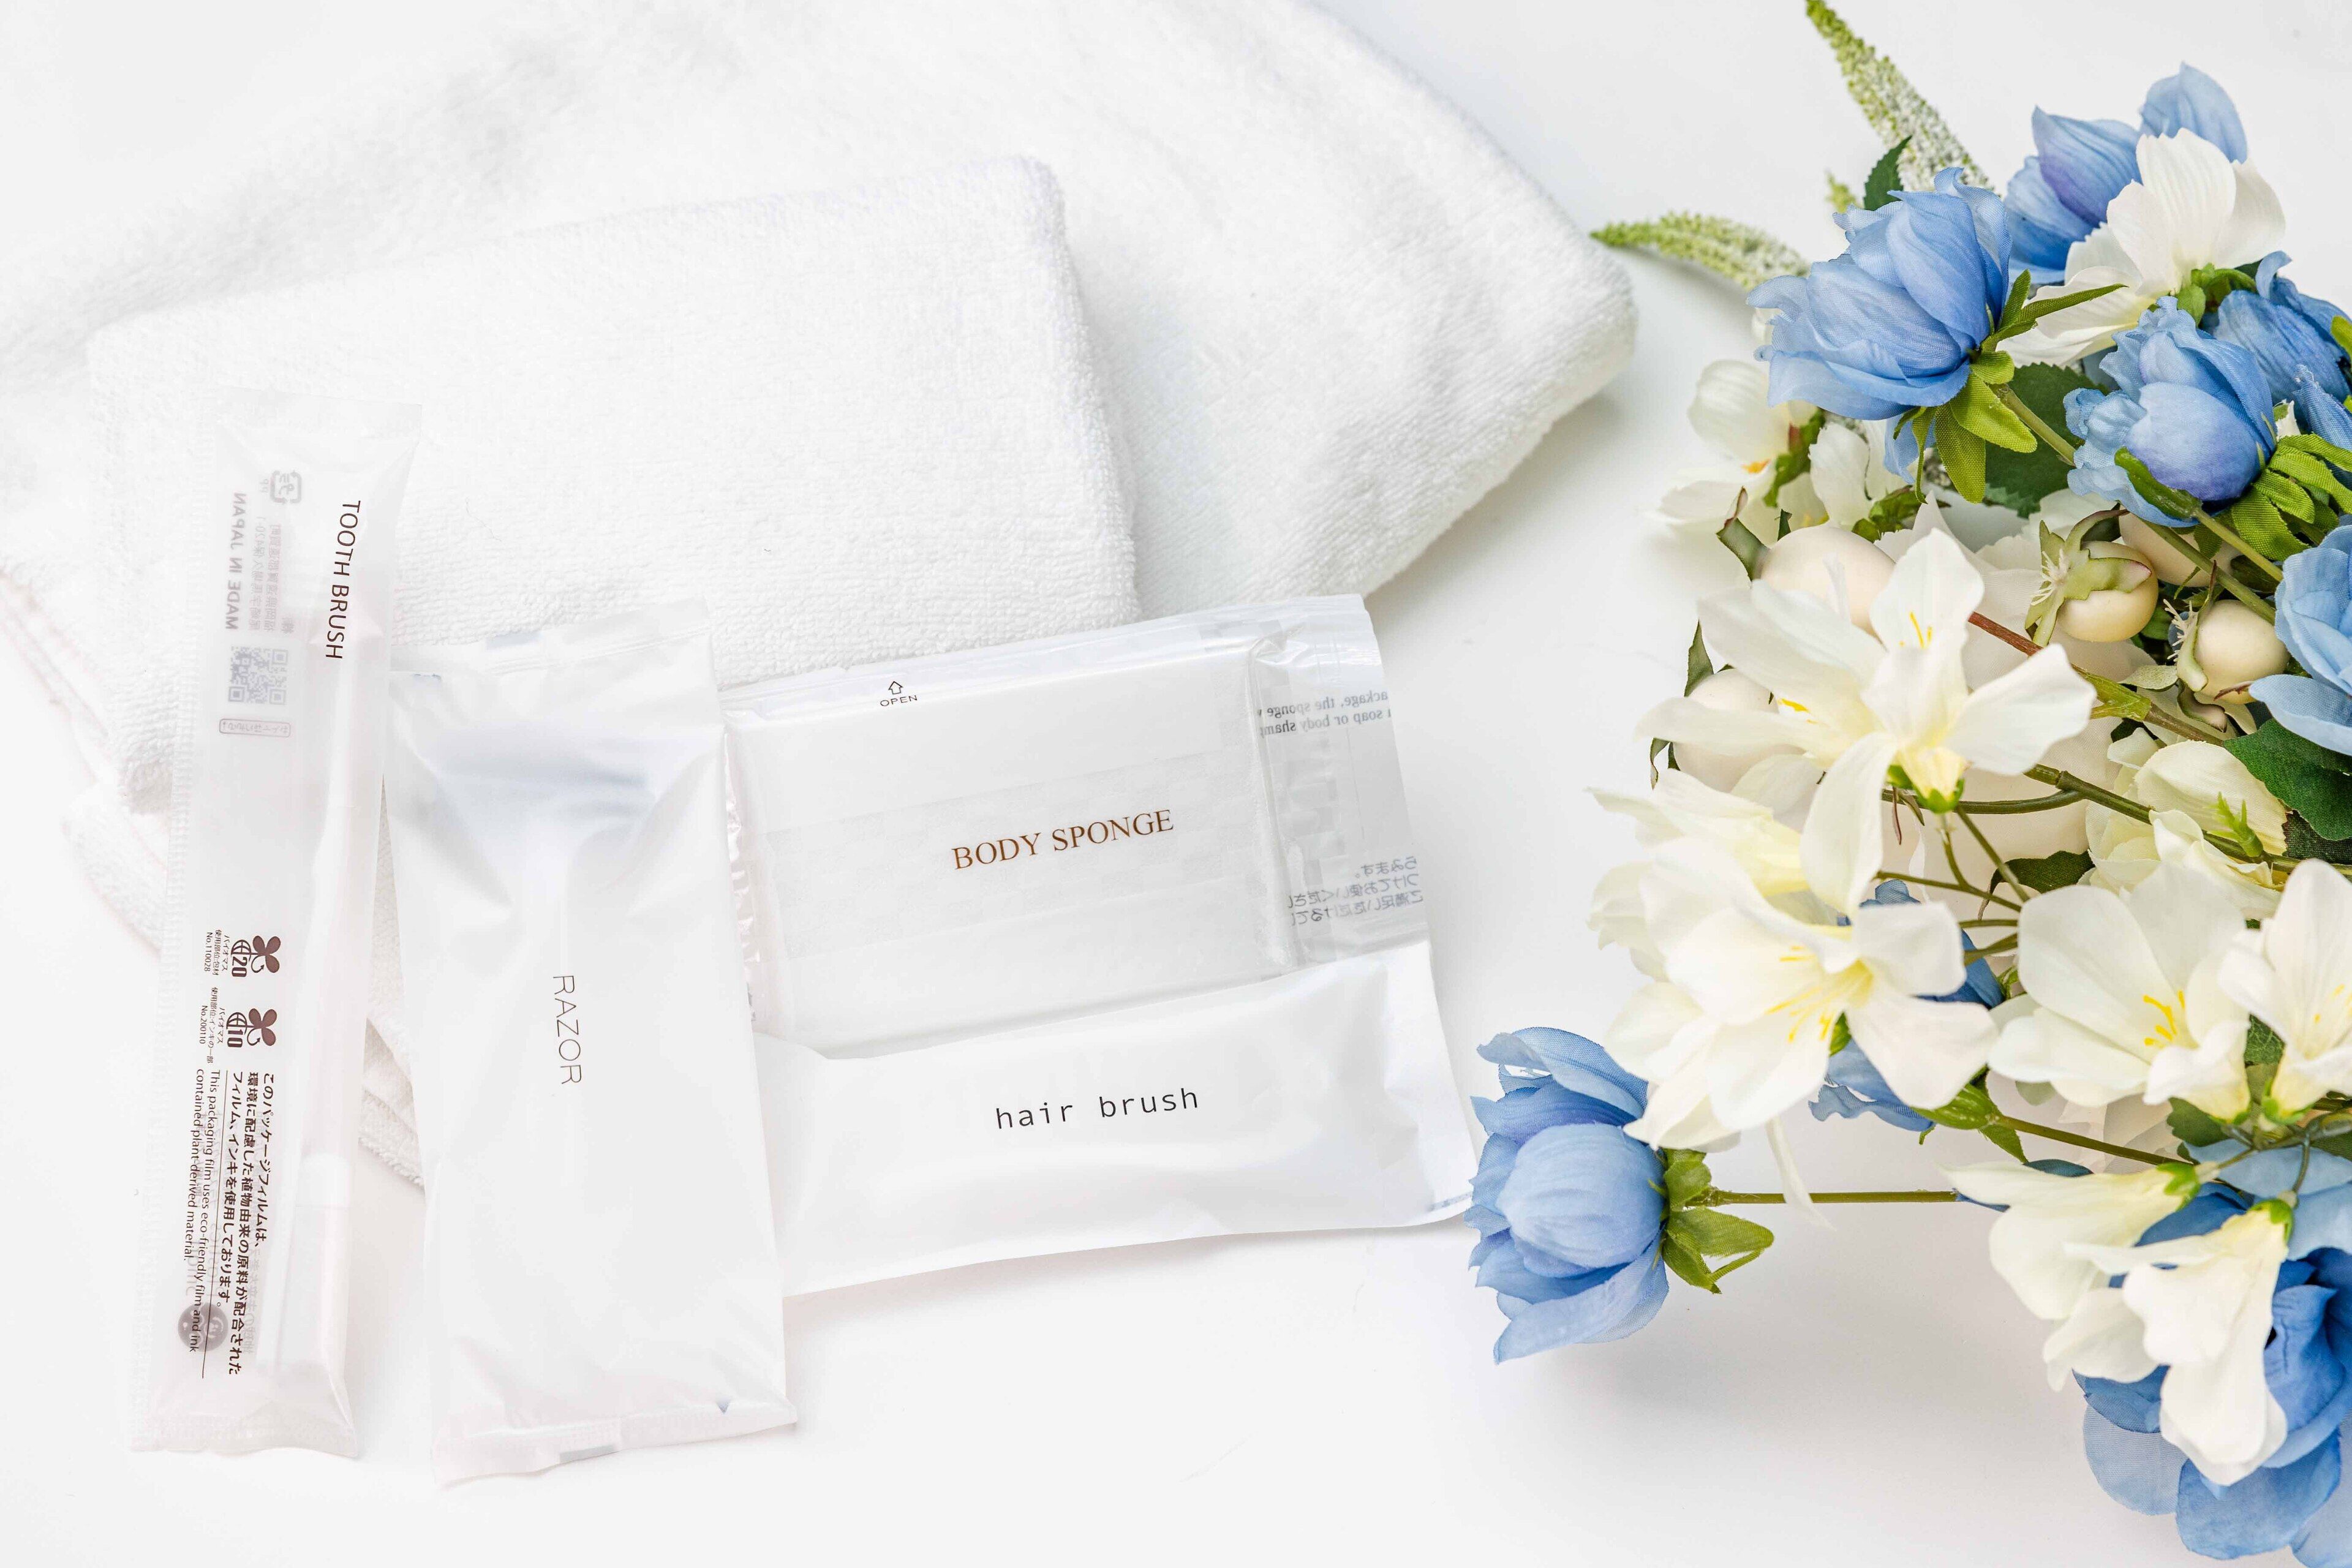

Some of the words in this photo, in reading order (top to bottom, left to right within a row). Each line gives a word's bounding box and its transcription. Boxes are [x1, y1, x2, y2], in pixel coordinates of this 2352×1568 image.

[333, 500, 362, 576] TOOTH
[325, 584, 350, 659] BRUSH
[880, 694, 918, 707] OPEN
[952, 832, 1042, 870] BODY
[1051, 809, 1174, 852] SPONGE
[204, 932, 213, 972] No.110028
[221, 935, 230, 971] バイオマス
[232, 956, 247, 978] 20
[199, 1005, 208, 1044] No.200110
[217, 1007, 226, 1044] バイオマス
[227, 1028, 243, 1048] 10
[552, 975, 582, 1084] RAZOR
[193, 1068, 205, 1127] contained
[209, 1069, 221, 1093] This
[203, 1095, 217, 1156] packaging
[995, 1102, 1073, 1129] hair
[1099, 1088, 1198, 1118] brush
[187, 1129, 202, 1208] plant-derived
[204, 1159, 215, 1180] film
[254, 1073, 274, 1247] このパッケージフィルムは、
[202, 1184, 211, 1210] uses
[216, 1071, 243, 1308] フィルム、インキを使用しております。
[184, 1210, 195, 1261] material.
[228, 1071, 258, 1375] 環境に配慮した植物由来の原料が配合された
[194, 1212, 209, 1282] eco-friendly
[195, 1284, 206, 1306] film
[190, 1309, 202, 1332] and
[189, 1334, 202, 1353] ink
